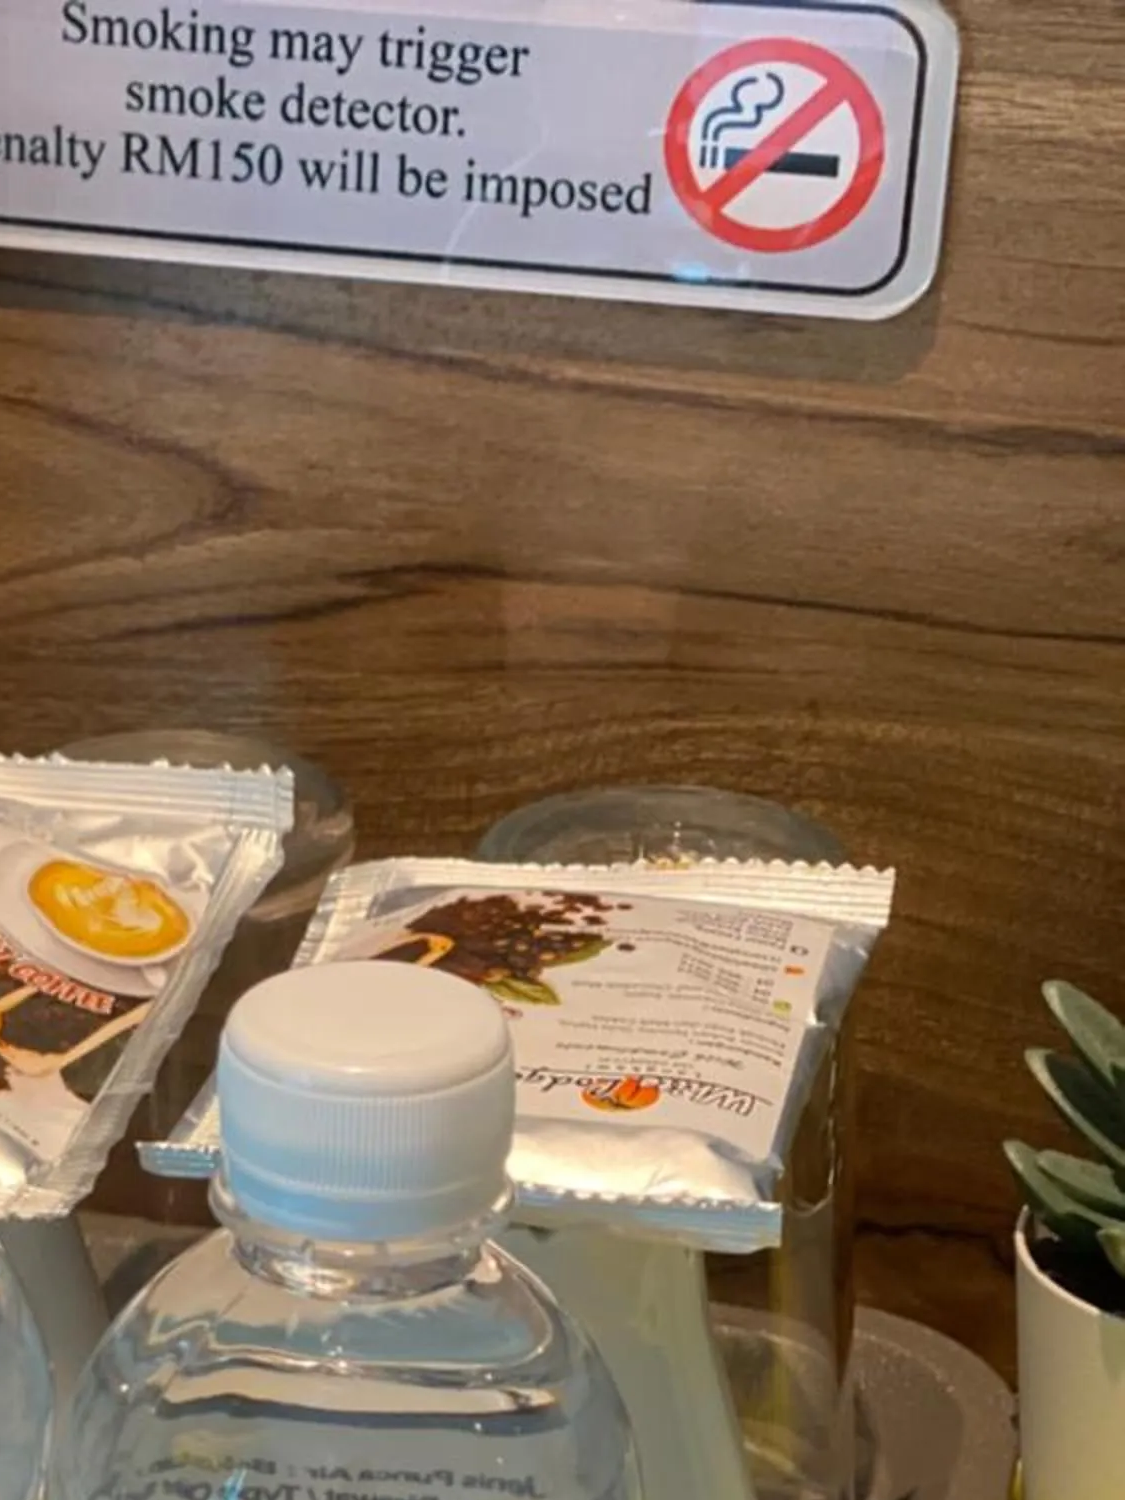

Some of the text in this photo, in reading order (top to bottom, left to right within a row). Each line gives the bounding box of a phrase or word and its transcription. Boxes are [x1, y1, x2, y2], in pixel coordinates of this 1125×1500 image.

[62, 0, 531, 85] Smoking may trigger
[125, 77, 465, 137] smoke detector.
[121, 132, 284, 186] RM150
[299, 149, 379, 193] will
[397, 154, 448, 198] be
[465, 159, 653, 217] imposed
